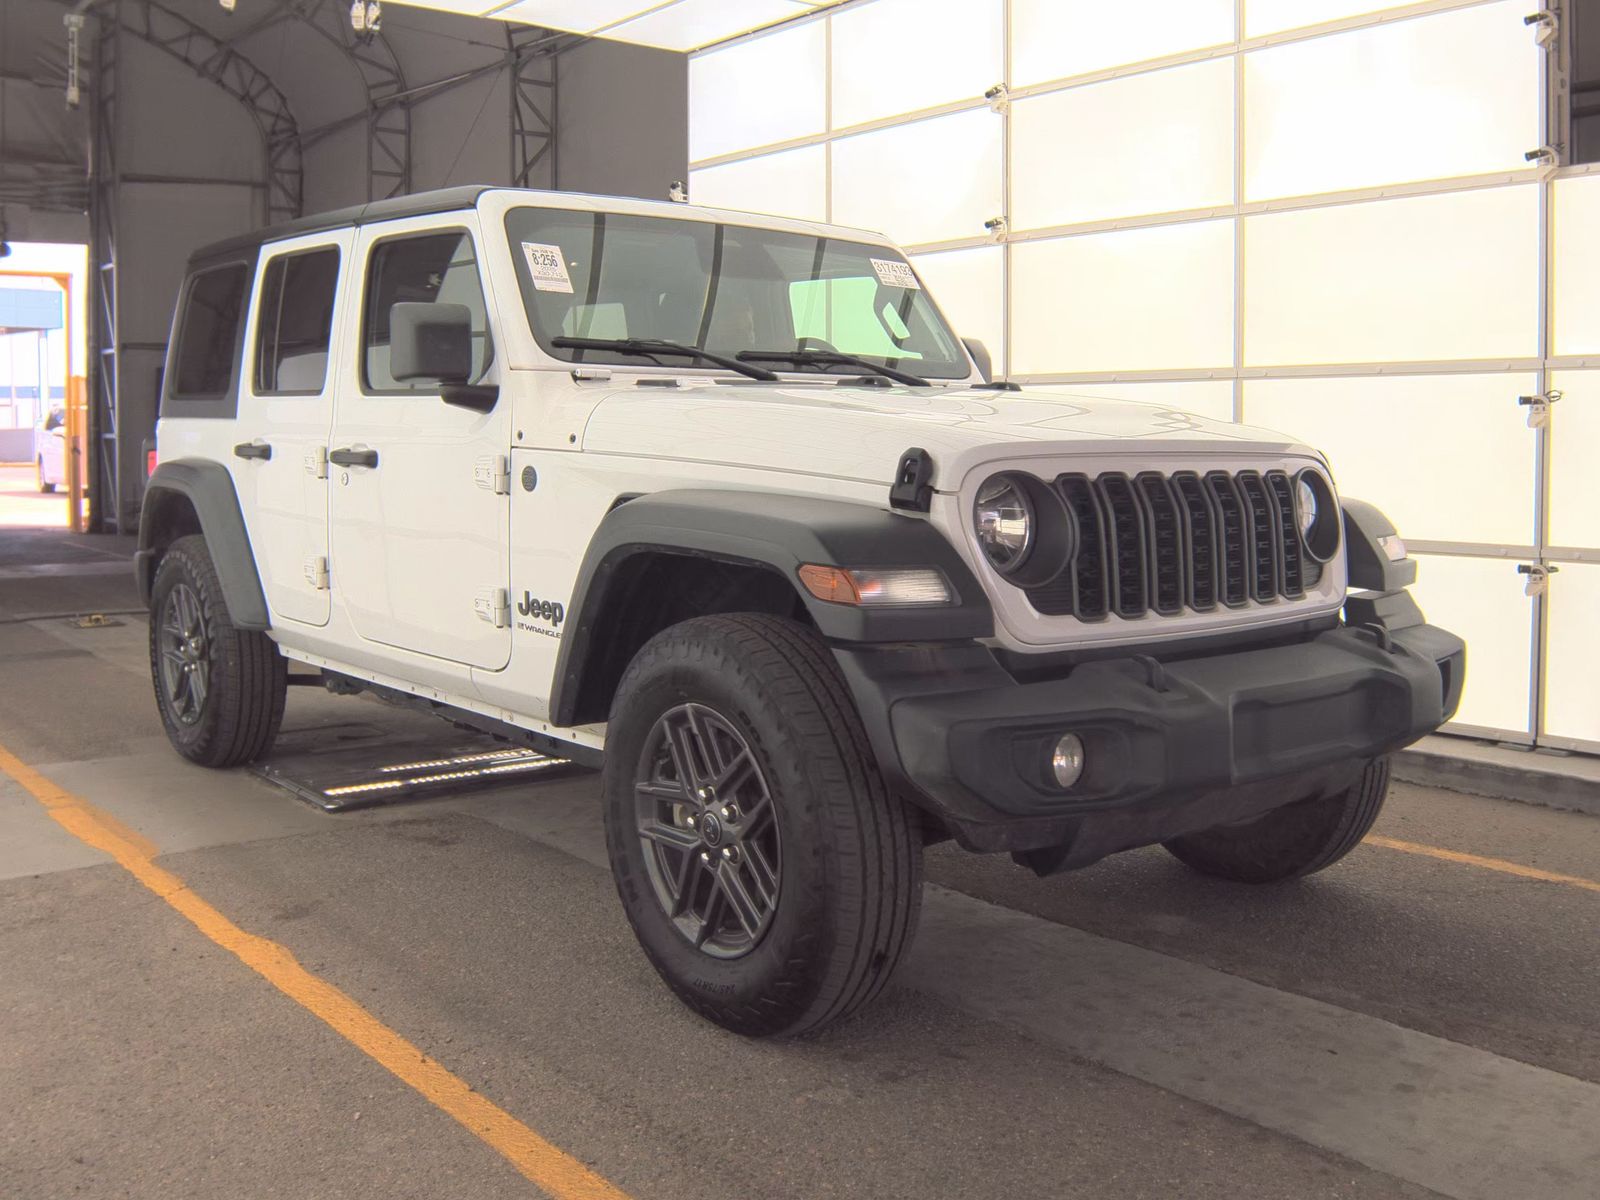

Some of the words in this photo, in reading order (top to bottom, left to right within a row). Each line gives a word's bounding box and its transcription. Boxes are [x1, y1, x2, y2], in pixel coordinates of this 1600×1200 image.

[532, 252, 558, 267] 8:256
[518, 590, 563, 626] Jeep
[525, 624, 562, 638] WRANGLE
